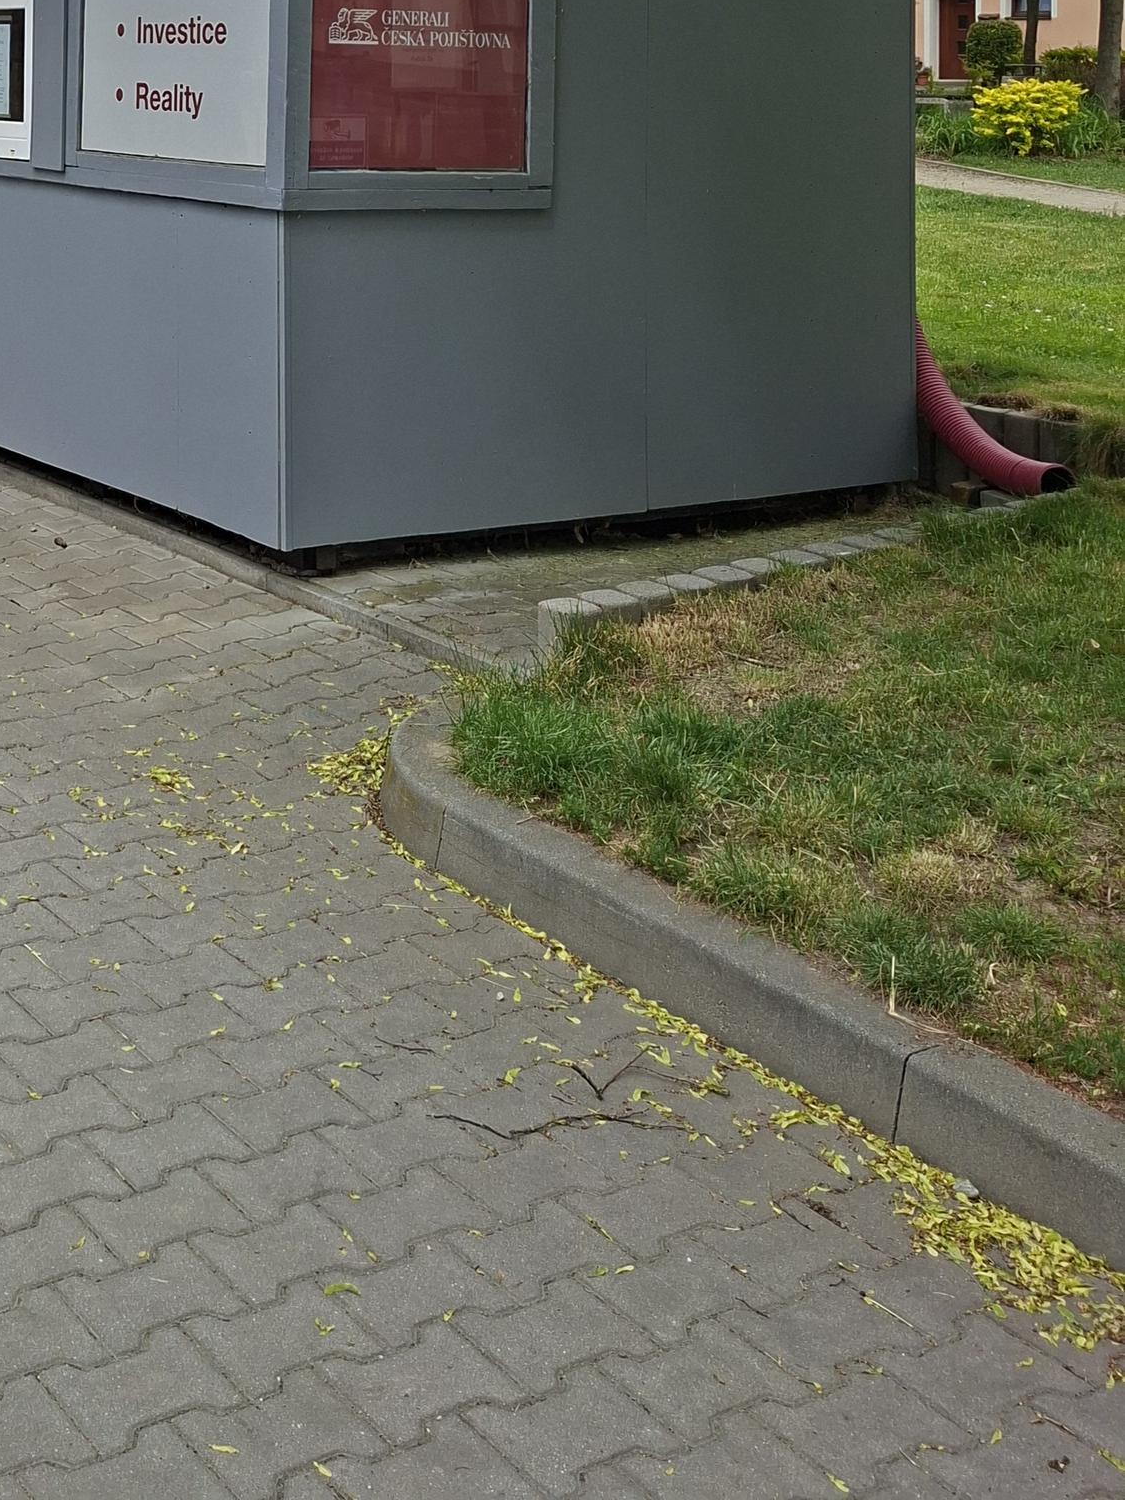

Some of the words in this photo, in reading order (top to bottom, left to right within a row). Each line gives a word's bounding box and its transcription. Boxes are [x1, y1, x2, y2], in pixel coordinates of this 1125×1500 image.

[137, 16, 227, 44] Investice
[381, 9, 449, 27] GENERALI
[381, 28, 426, 47] ČESKÁ
[429, 29, 511, 49] POJIŠŤOVNA
[135, 82, 204, 120] Reality
